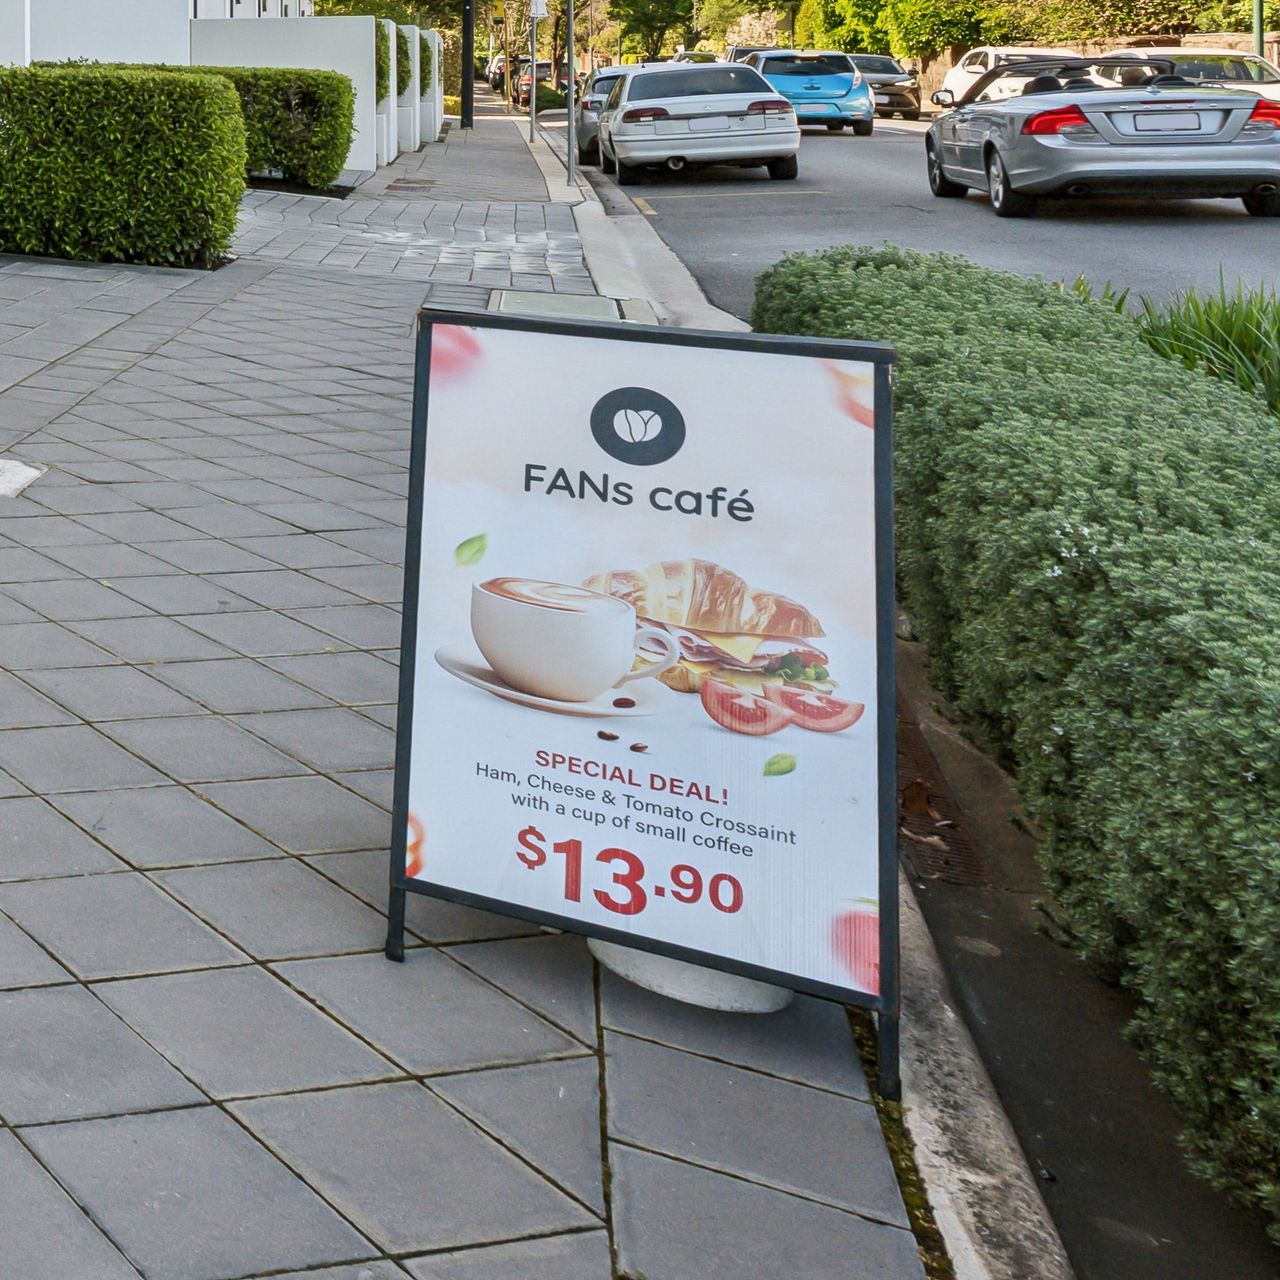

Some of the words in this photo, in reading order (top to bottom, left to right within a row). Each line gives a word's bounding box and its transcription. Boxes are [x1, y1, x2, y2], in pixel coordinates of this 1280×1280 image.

[524, 463, 634, 506] FANs
[648, 488, 755, 522] café
[476, 761, 521, 787] Ham,
[526, 773, 596, 801] Cheese
[601, 789, 617, 806] &
[622, 793, 694, 823] Tomato
[699, 811, 797, 846] Crossaint
[534, 749, 642, 788] SPECIAL
[649, 772, 728, 806] DEAL!
[511, 793, 550, 812] with
[555, 803, 566, 816] a
[571, 806, 606, 826] cup
[611, 814, 631, 830] of
[635, 821, 686, 843] small
[692, 833, 754, 857] coffee
[515, 824, 744, 916] $13.90
